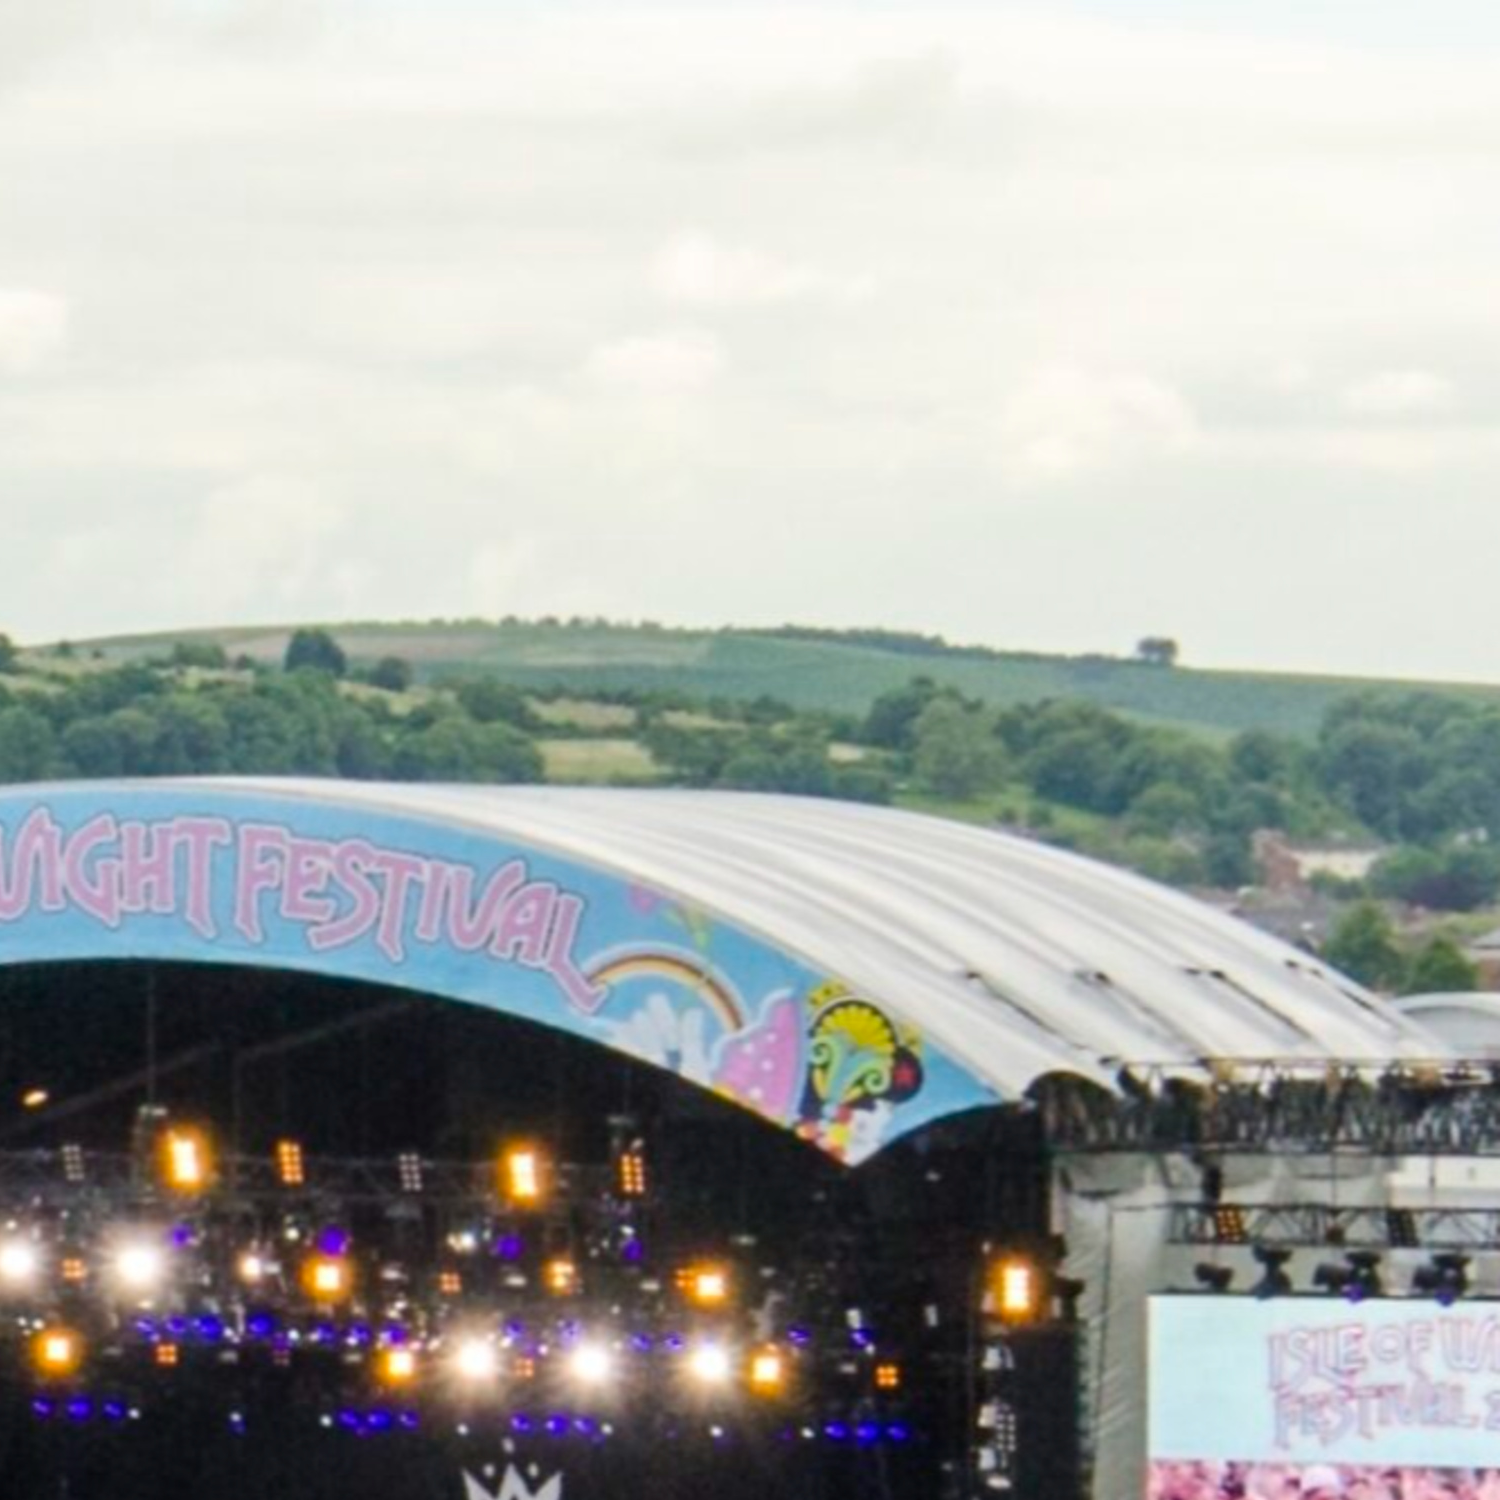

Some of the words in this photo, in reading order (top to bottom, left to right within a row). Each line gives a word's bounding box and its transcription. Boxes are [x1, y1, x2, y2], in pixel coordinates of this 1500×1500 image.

[233, 822, 611, 1015] FESTIVAL
[1266, 1322, 1369, 1392] ISLE
[1370, 1318, 1435, 1381] OF
